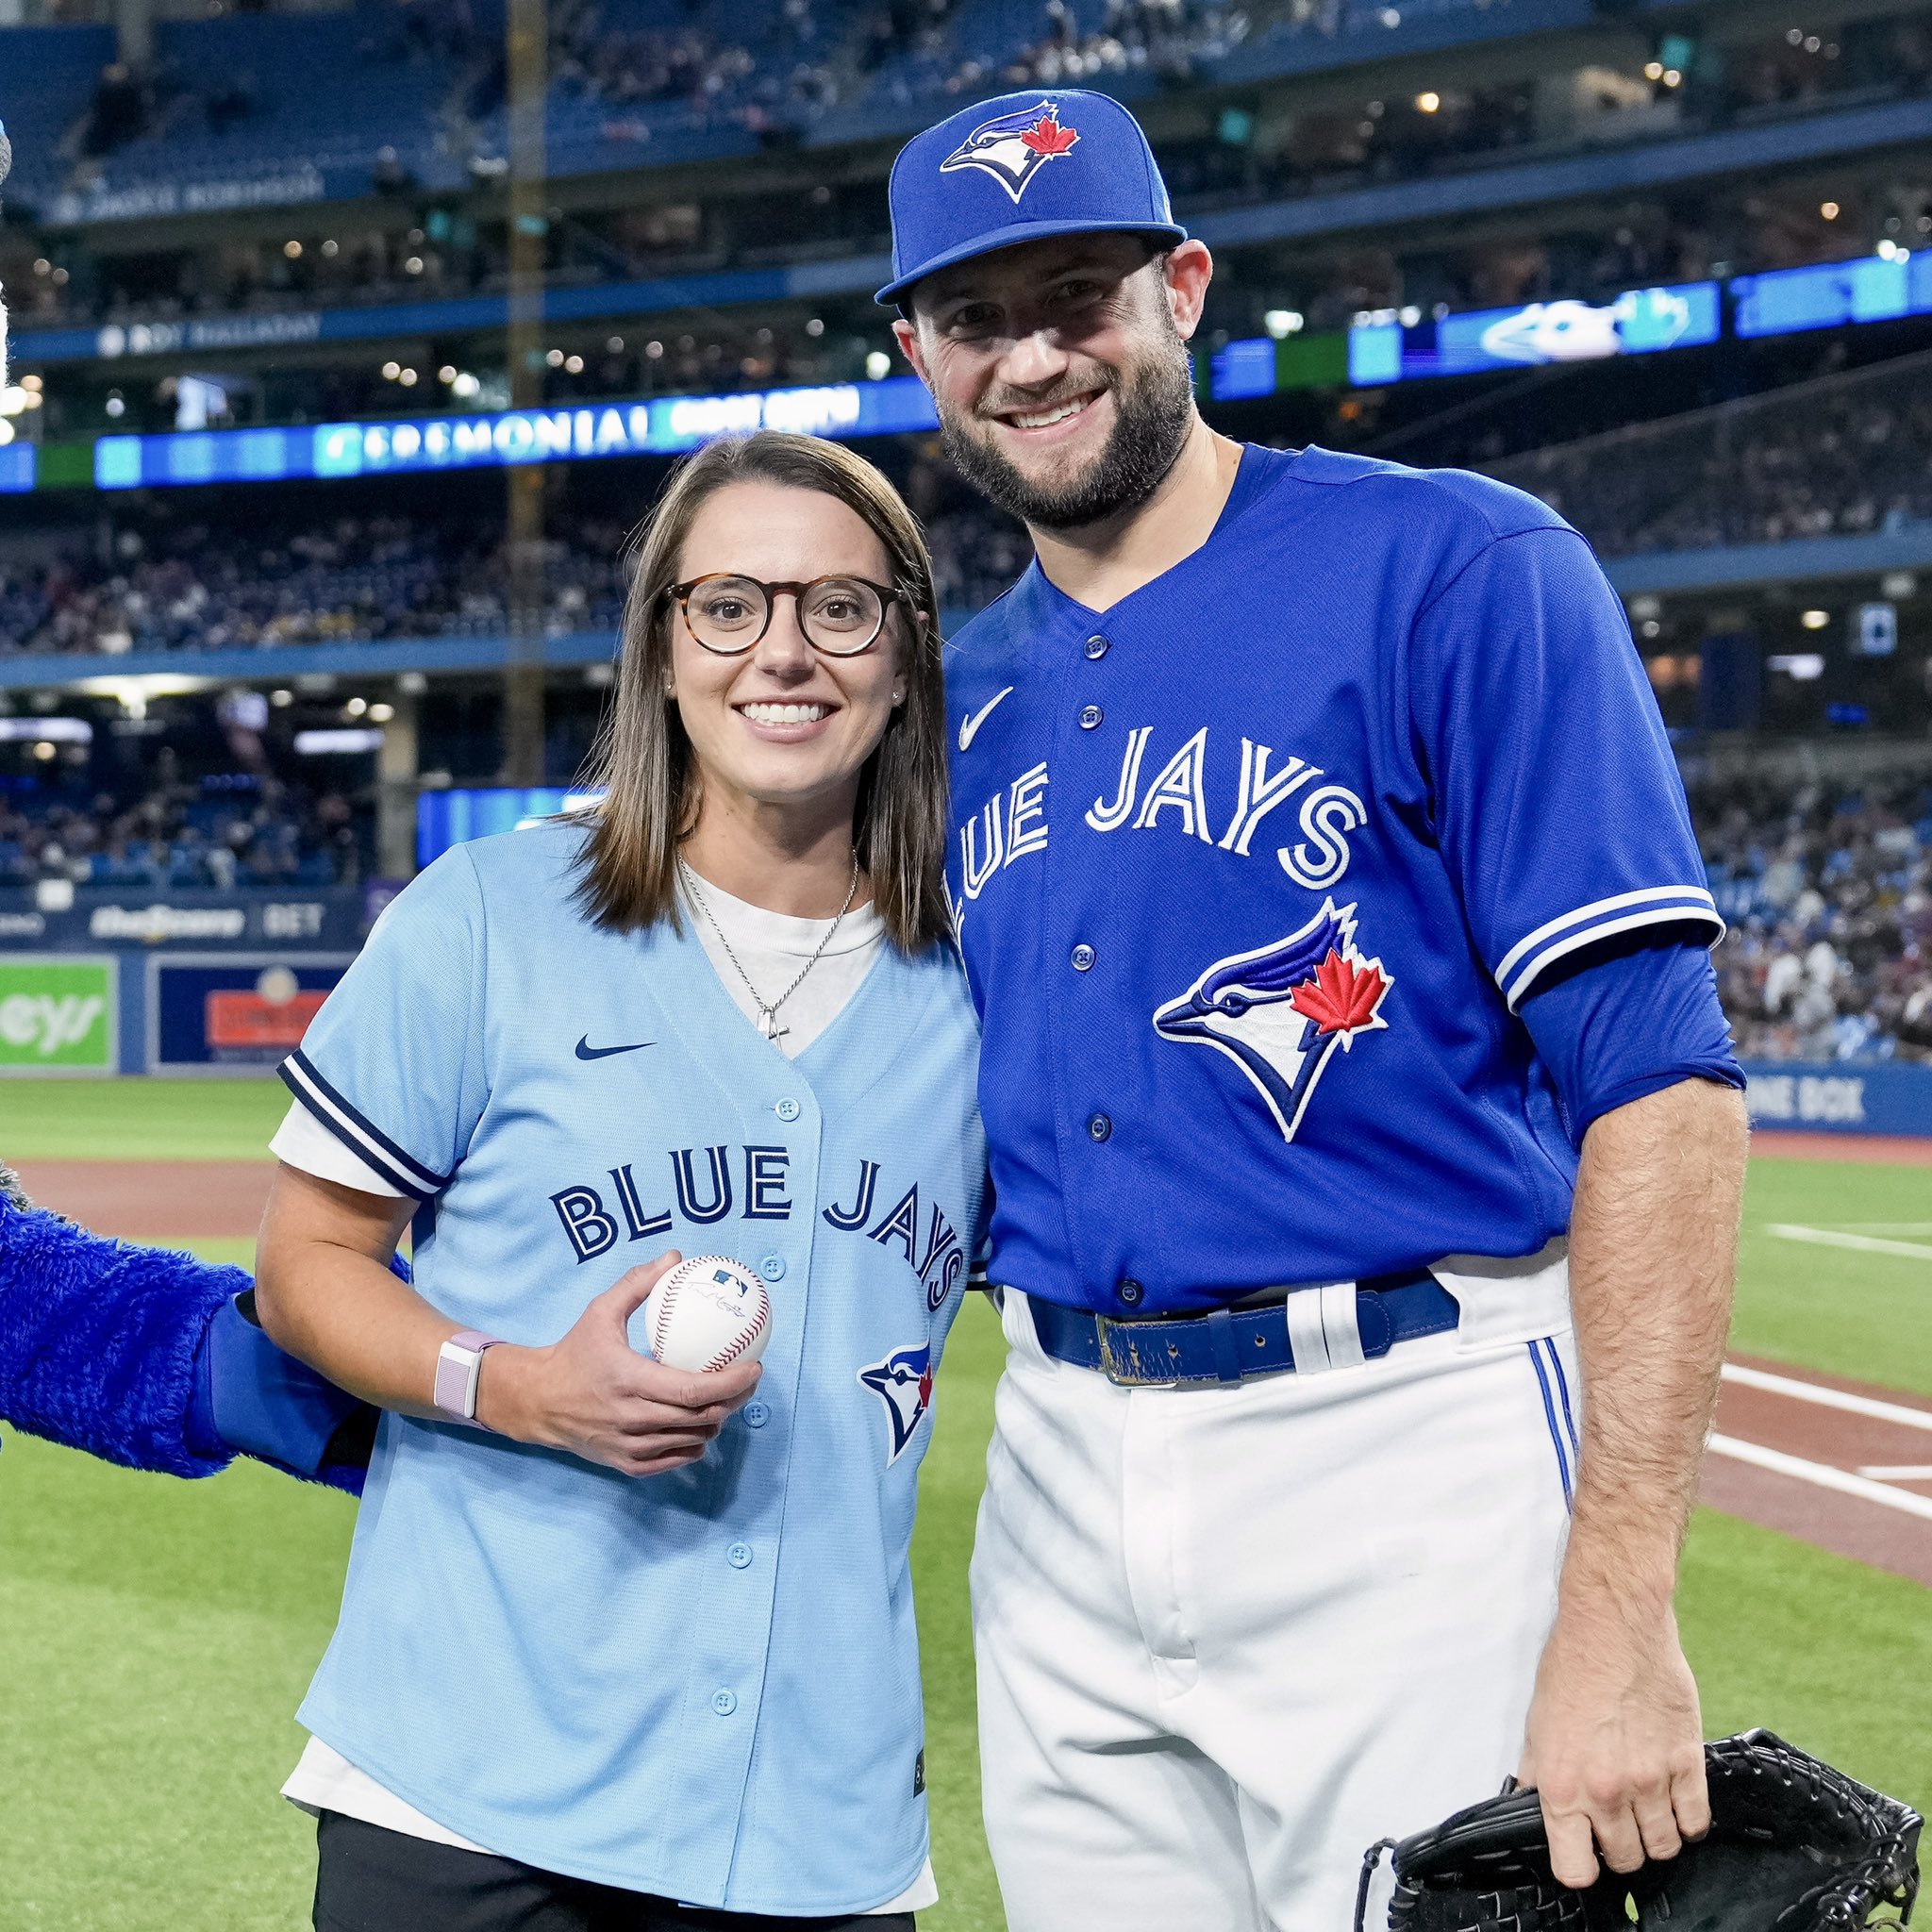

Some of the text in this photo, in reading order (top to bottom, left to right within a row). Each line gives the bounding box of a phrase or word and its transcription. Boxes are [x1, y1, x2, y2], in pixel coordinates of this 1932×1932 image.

[1084, 725, 1368, 891] JAYS
[0, 994, 103, 1056] eys
[1746, 1074, 1865, 1121] NE BOX
[548, 1144, 964, 1312] BLUE JAYS
